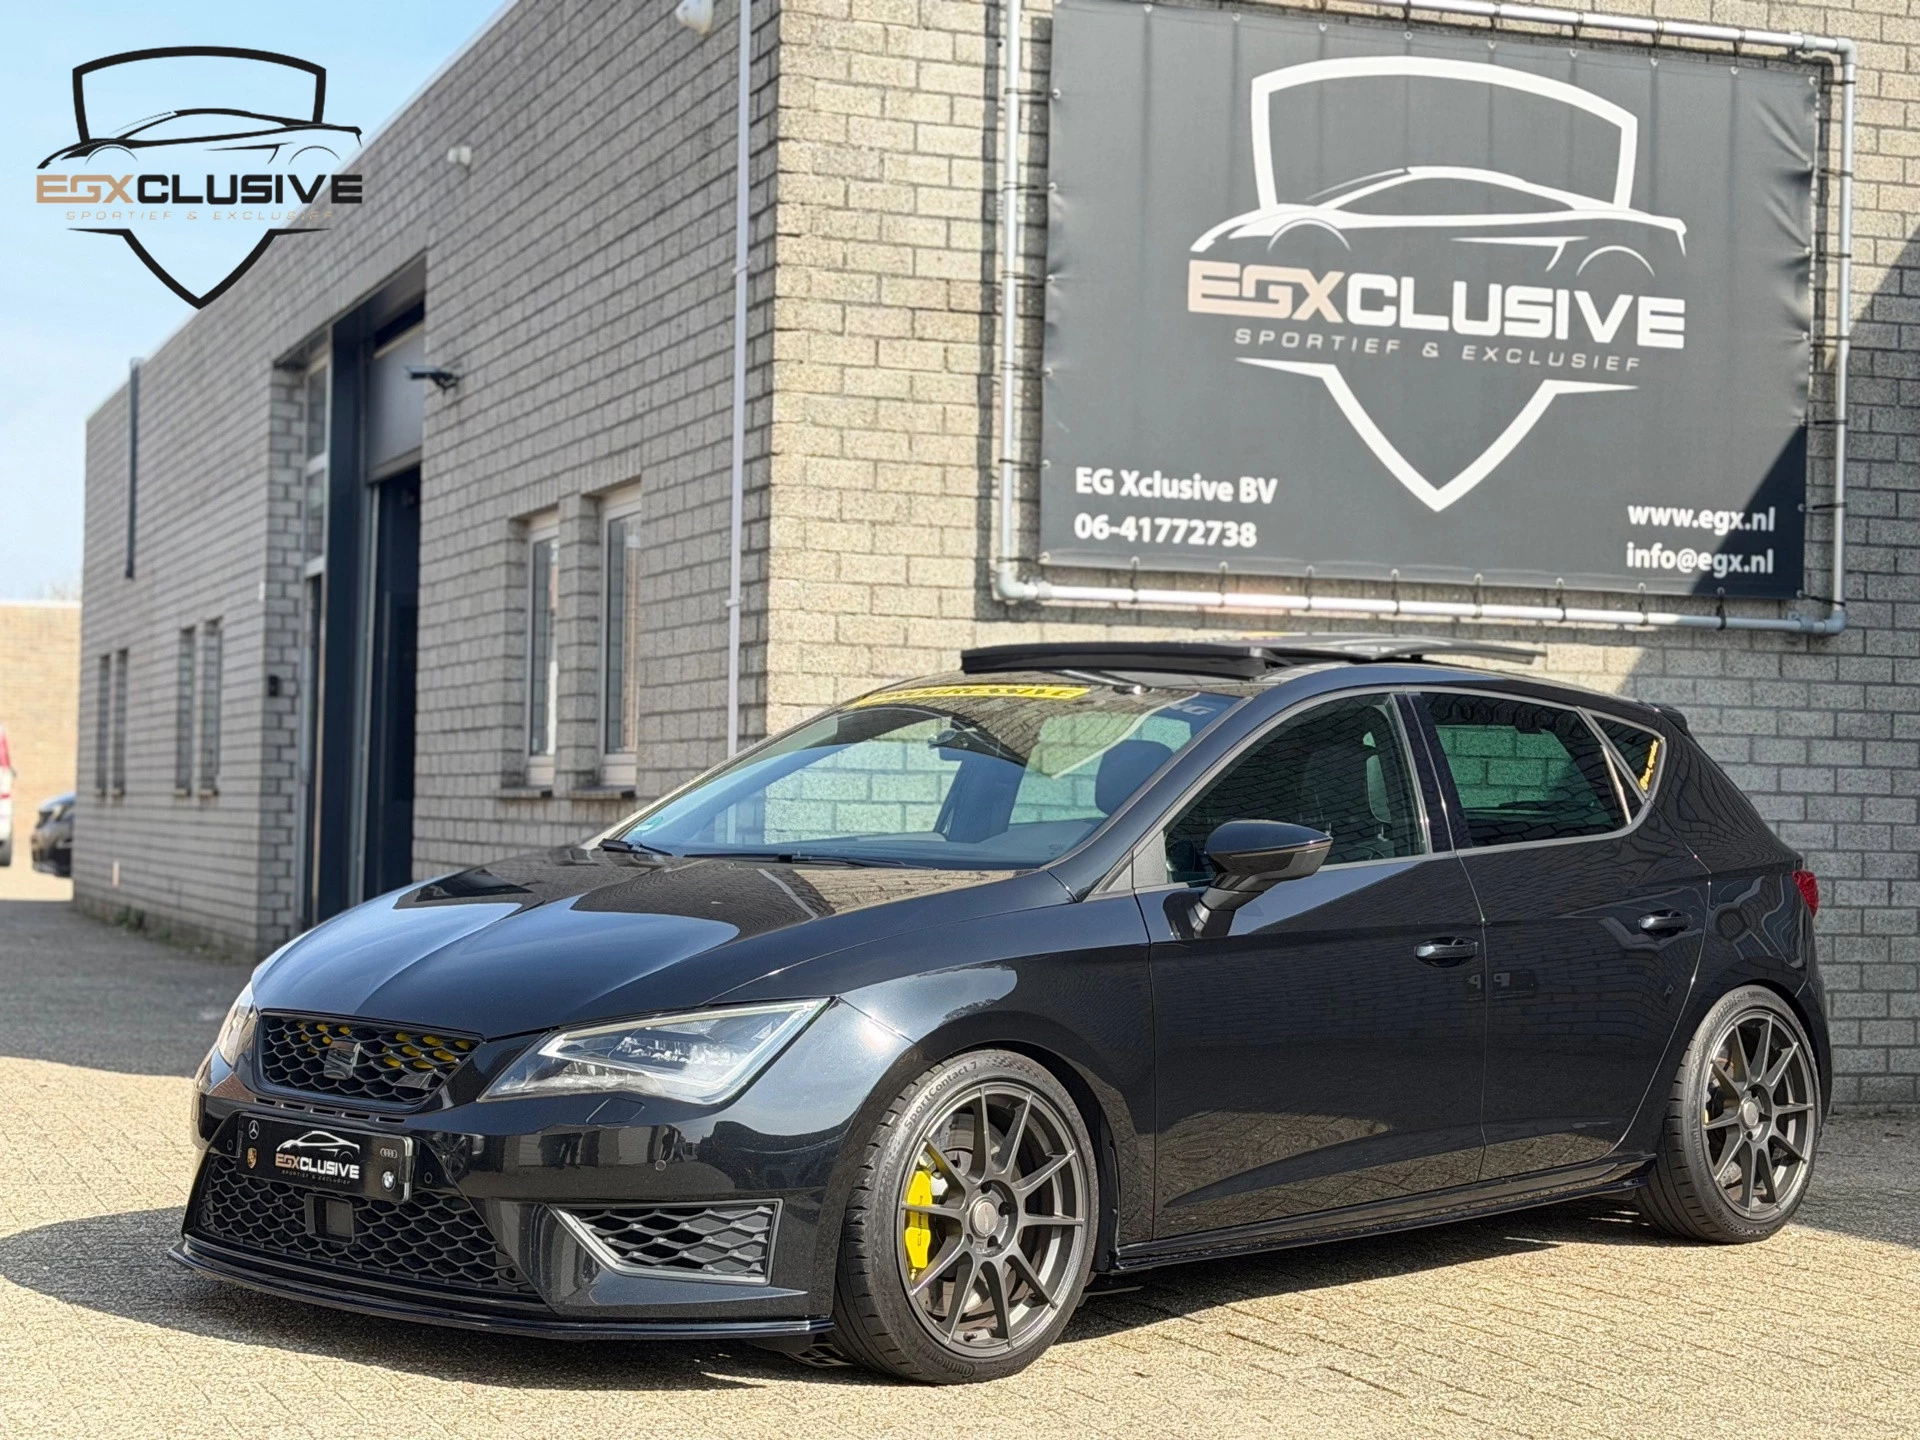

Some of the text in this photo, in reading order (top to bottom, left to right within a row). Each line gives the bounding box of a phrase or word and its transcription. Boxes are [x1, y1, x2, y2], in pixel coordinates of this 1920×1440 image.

[1188, 260, 1686, 350] EGXCLUSIVE
[1234, 328, 1642, 372] SPORTIEF & EXCLUSIEF
[1075, 467, 1278, 504] EG Xclusive BV
[1074, 513, 1258, 548] 06-41772738
[1627, 505, 1776, 536] www.egx.nl
[1626, 541, 1774, 579] info@egx.nl
[904, 1065, 968, 1130] SportContact
[275, 1153, 360, 1179] EGXCLUSIVE
